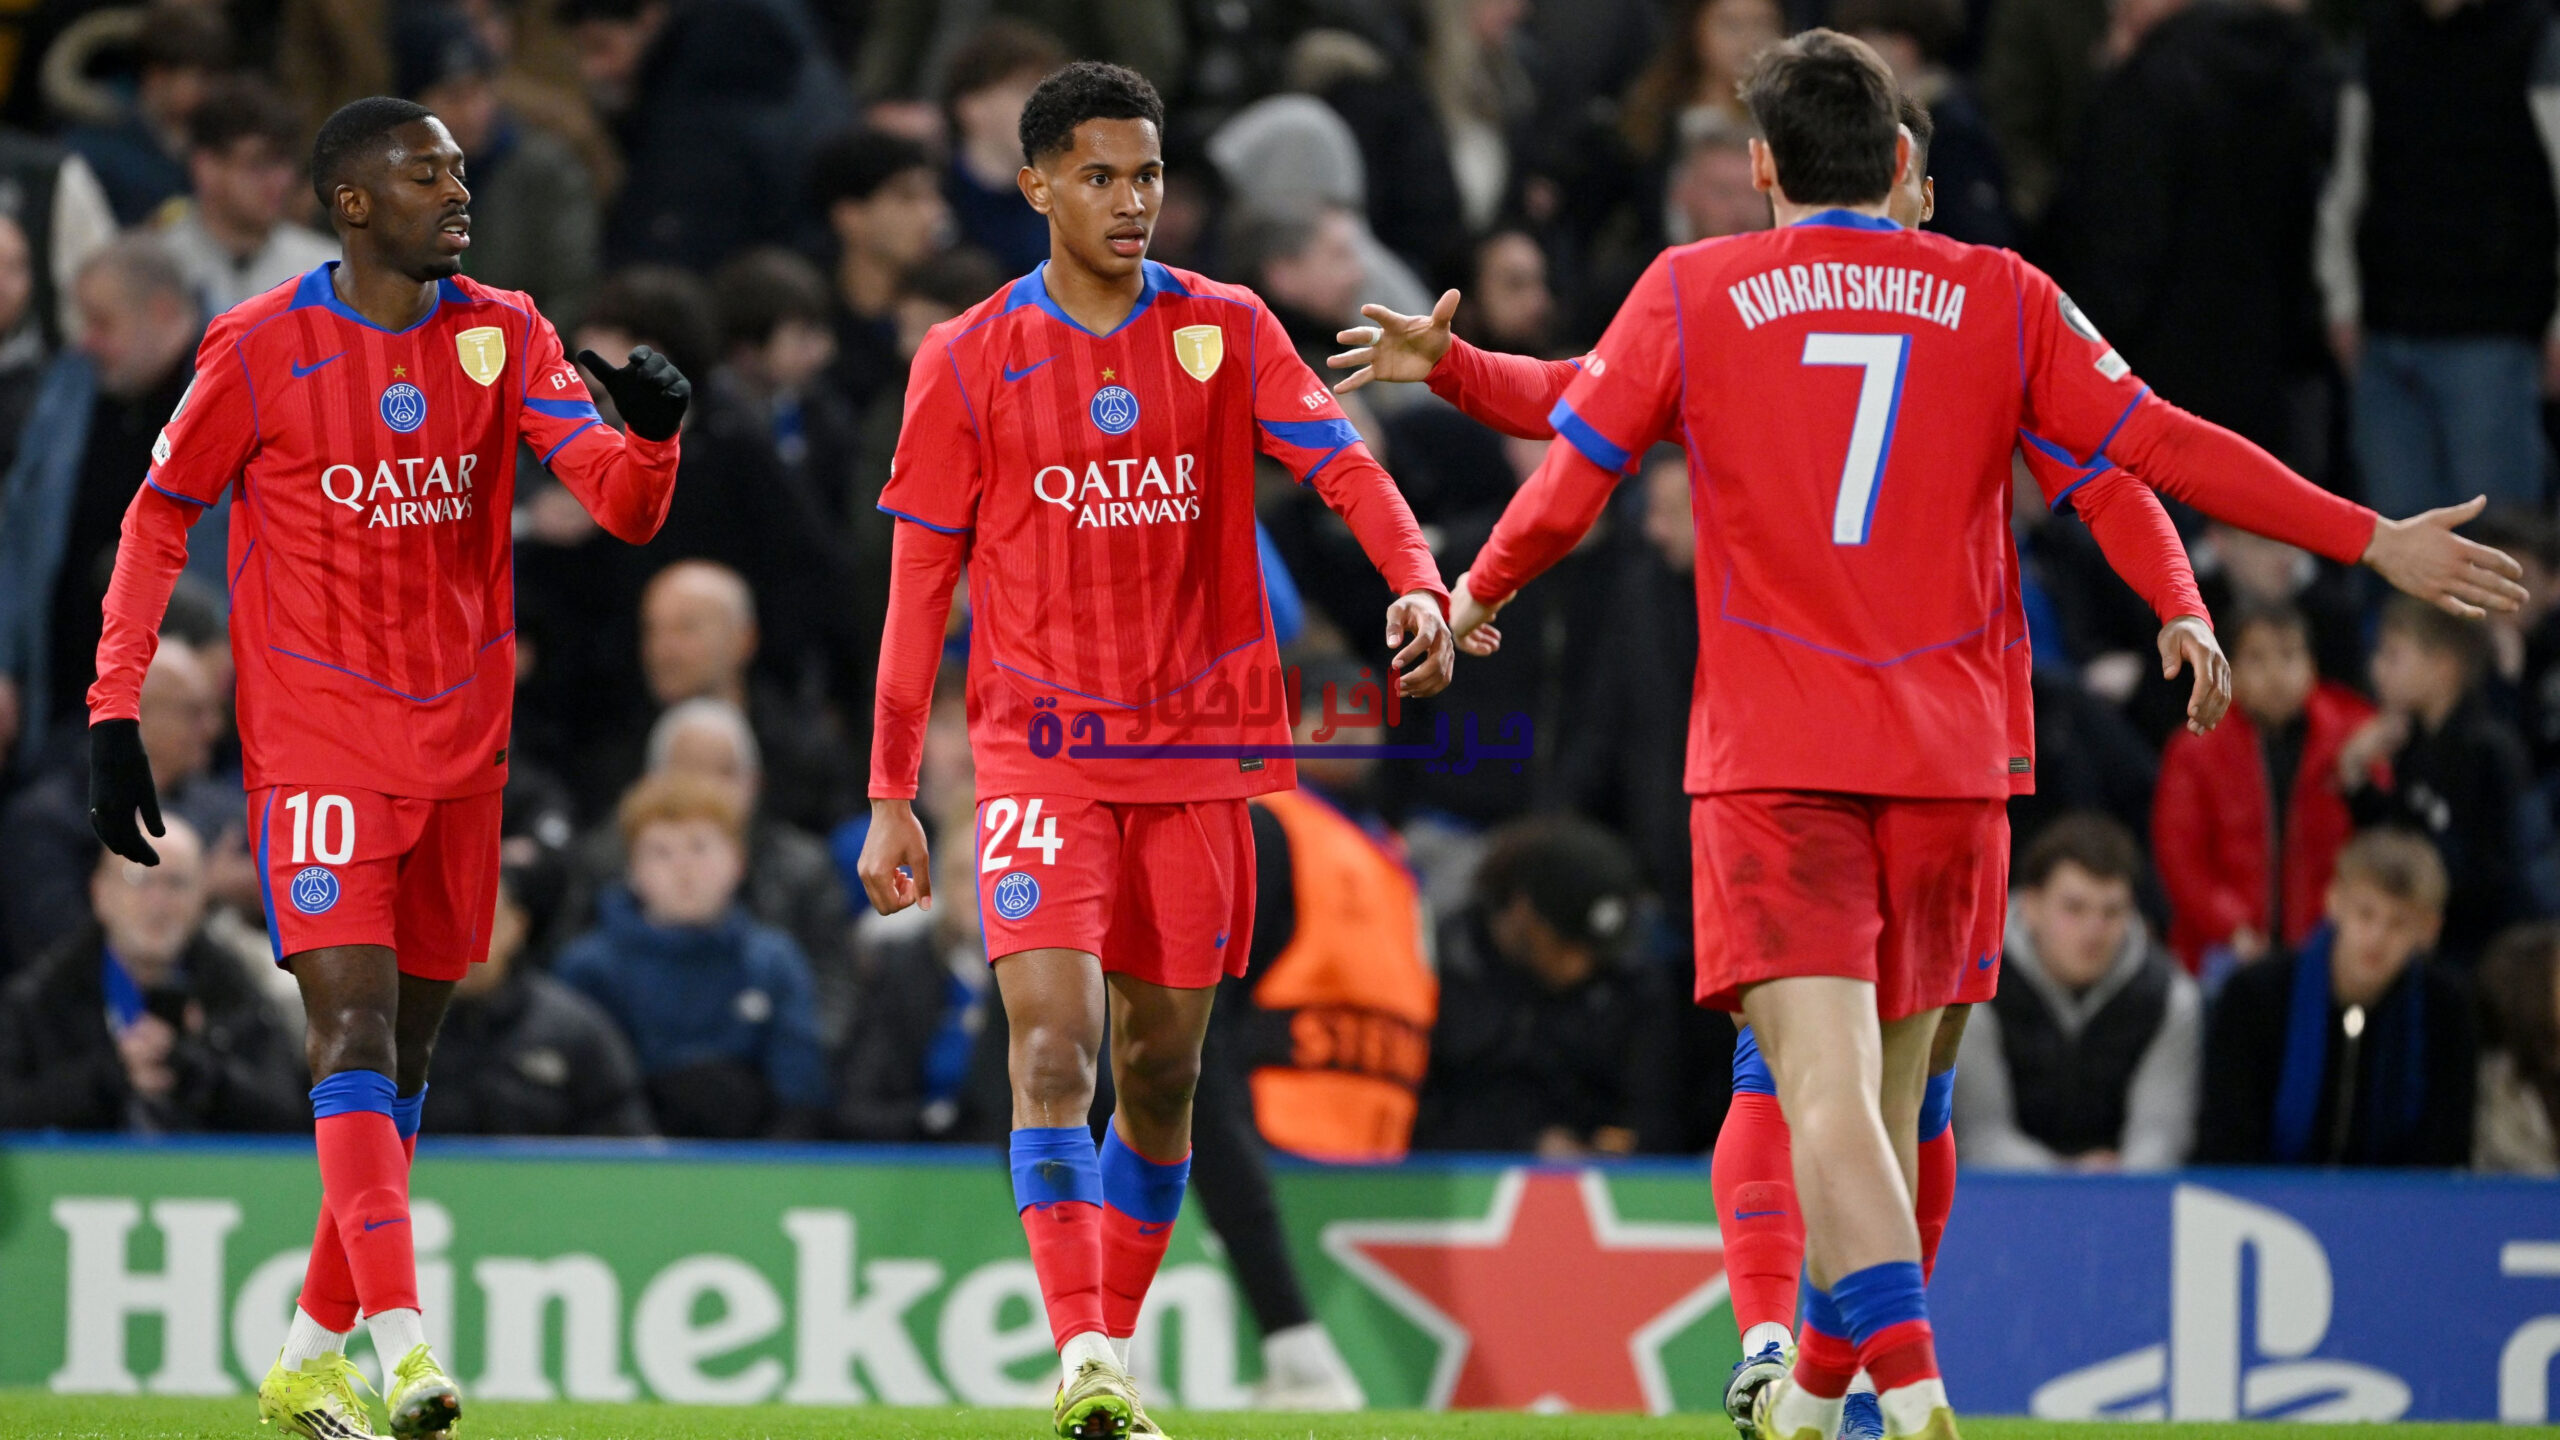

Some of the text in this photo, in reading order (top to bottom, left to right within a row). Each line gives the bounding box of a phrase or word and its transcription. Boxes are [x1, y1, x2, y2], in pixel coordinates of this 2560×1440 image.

[1728, 262, 1966, 331] KVARATSKHELIA
[386, 385, 415, 399] PARIS
[1097, 388, 1127, 401] PARIS
[1801, 332, 1913, 545] 7
[321, 453, 478, 513] QATAR
[1033, 453, 1197, 513] QATAR
[367, 493, 473, 529] AIRWAYS
[1076, 496, 1201, 529] AIRWAYS
[284, 791, 356, 865] 10
[981, 798, 1065, 874] 24
[298, 869, 330, 882] PARIS
[1001, 875, 1031, 889] PARIS
